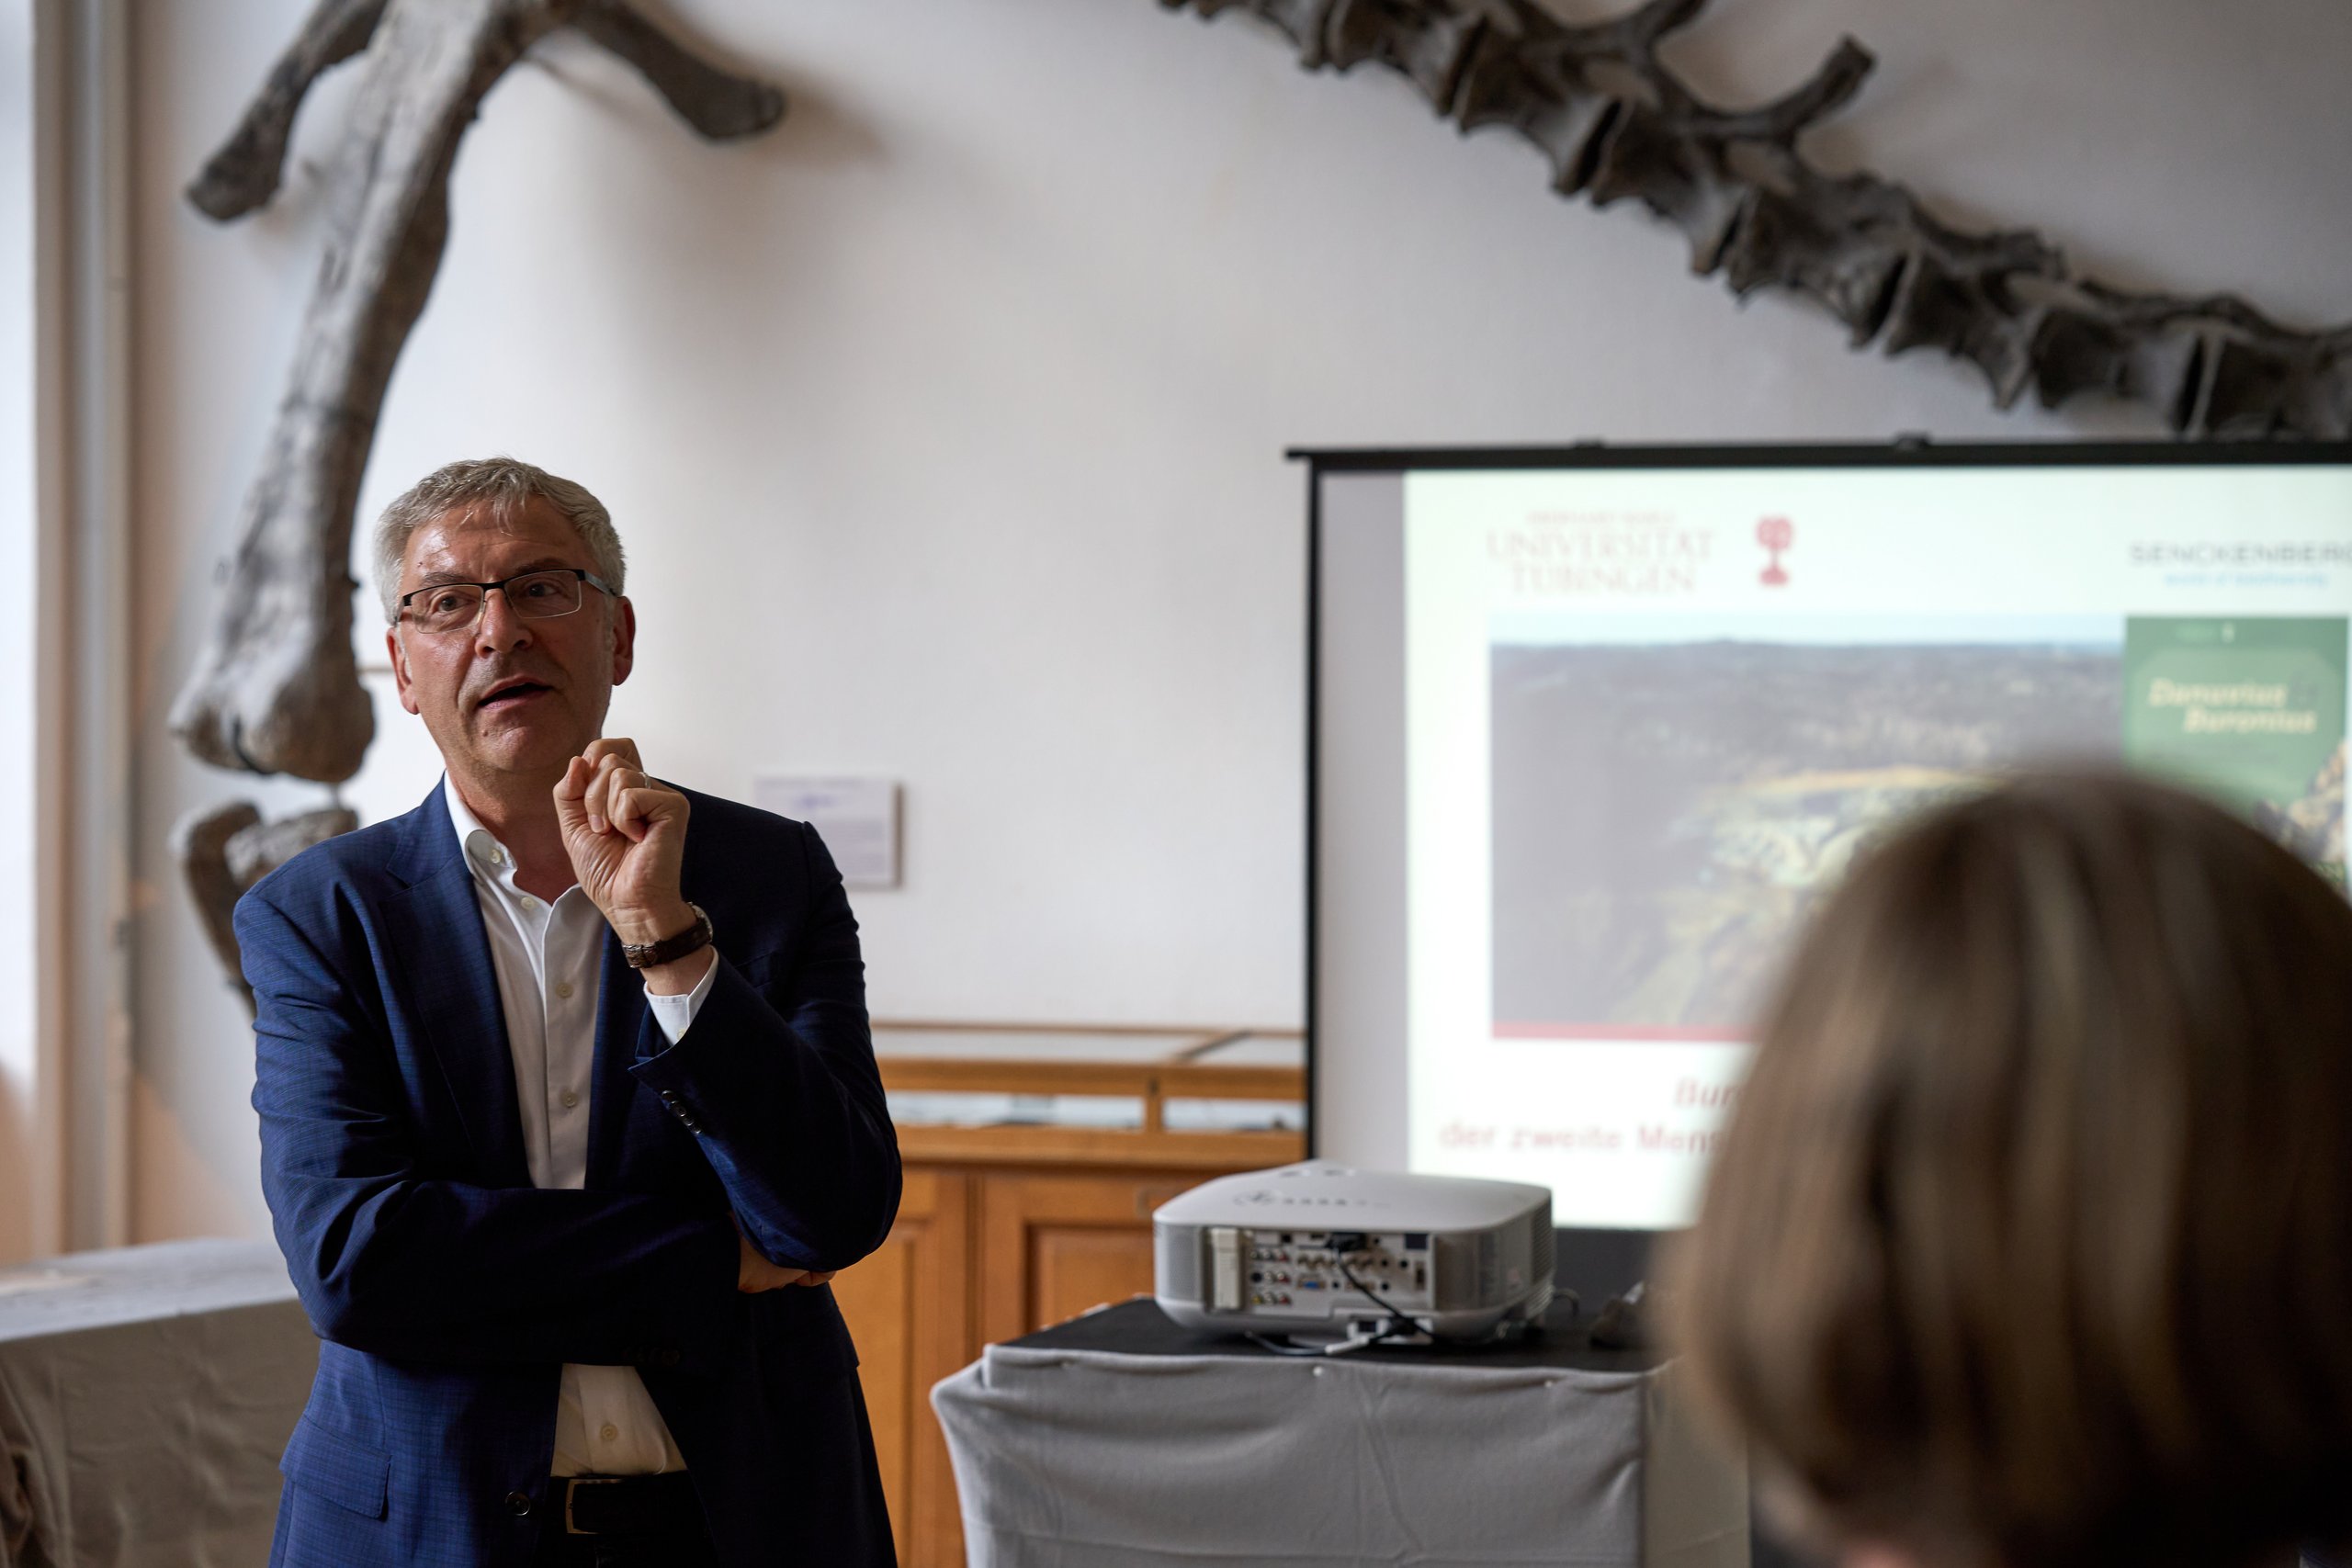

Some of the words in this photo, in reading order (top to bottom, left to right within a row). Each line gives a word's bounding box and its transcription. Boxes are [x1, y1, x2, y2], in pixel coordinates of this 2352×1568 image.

[1674, 1077, 1738, 1108] Bur
[1438, 1119, 1497, 1148] der
[1510, 1124, 1622, 1150] zweite
[1637, 1123, 1729, 1155] Mens
